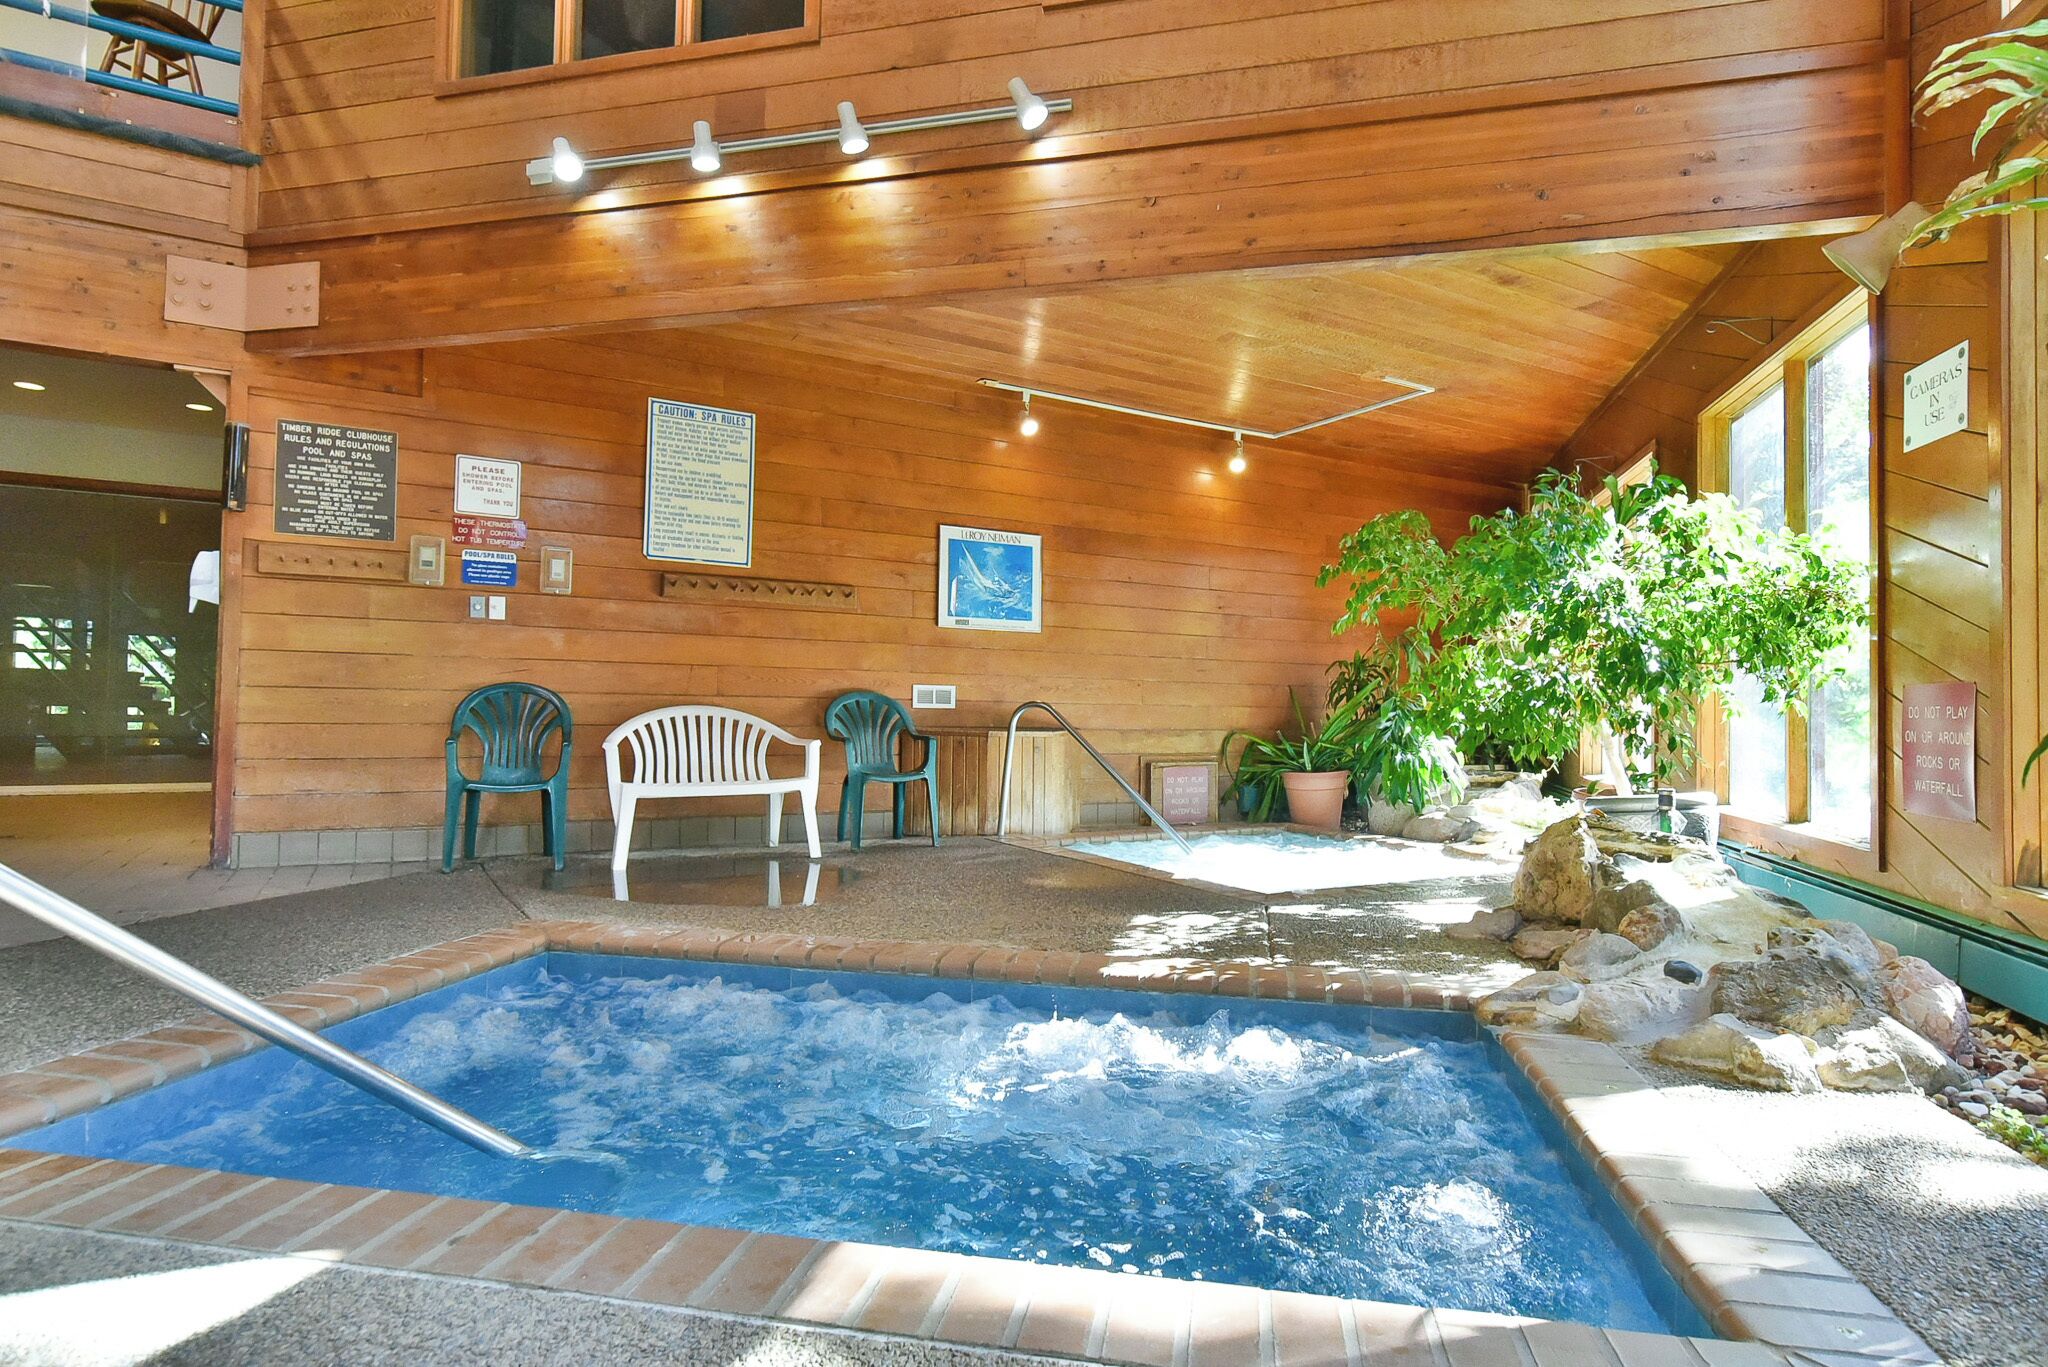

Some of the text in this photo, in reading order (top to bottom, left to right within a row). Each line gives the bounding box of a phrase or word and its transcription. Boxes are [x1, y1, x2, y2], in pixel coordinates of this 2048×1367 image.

[1910, 362, 1962, 400] CAMERAS
[1930, 392, 1940, 408] IN
[658, 404, 697, 419] CAUTION:
[702, 411, 716, 422] SPA
[721, 415, 746, 426] RULES
[1924, 406, 1945, 426] USE
[281, 423, 393, 443] TIMBER RIDGE CLUBHOUSE
[284, 434, 390, 452] RULES AND REGULATIONS
[302, 446, 372, 461] POOL AND SPAS
[472, 466, 505, 474] PLEASE
[987, 532, 1021, 544] NEIMAN
[1908, 706, 1968, 719] DO NOT PLAY
[1905, 730, 1971, 746] ON OR AROUND
[1916, 755, 1960, 770] ROCKS OR
[1914, 780, 1964, 797] WATERFALL
